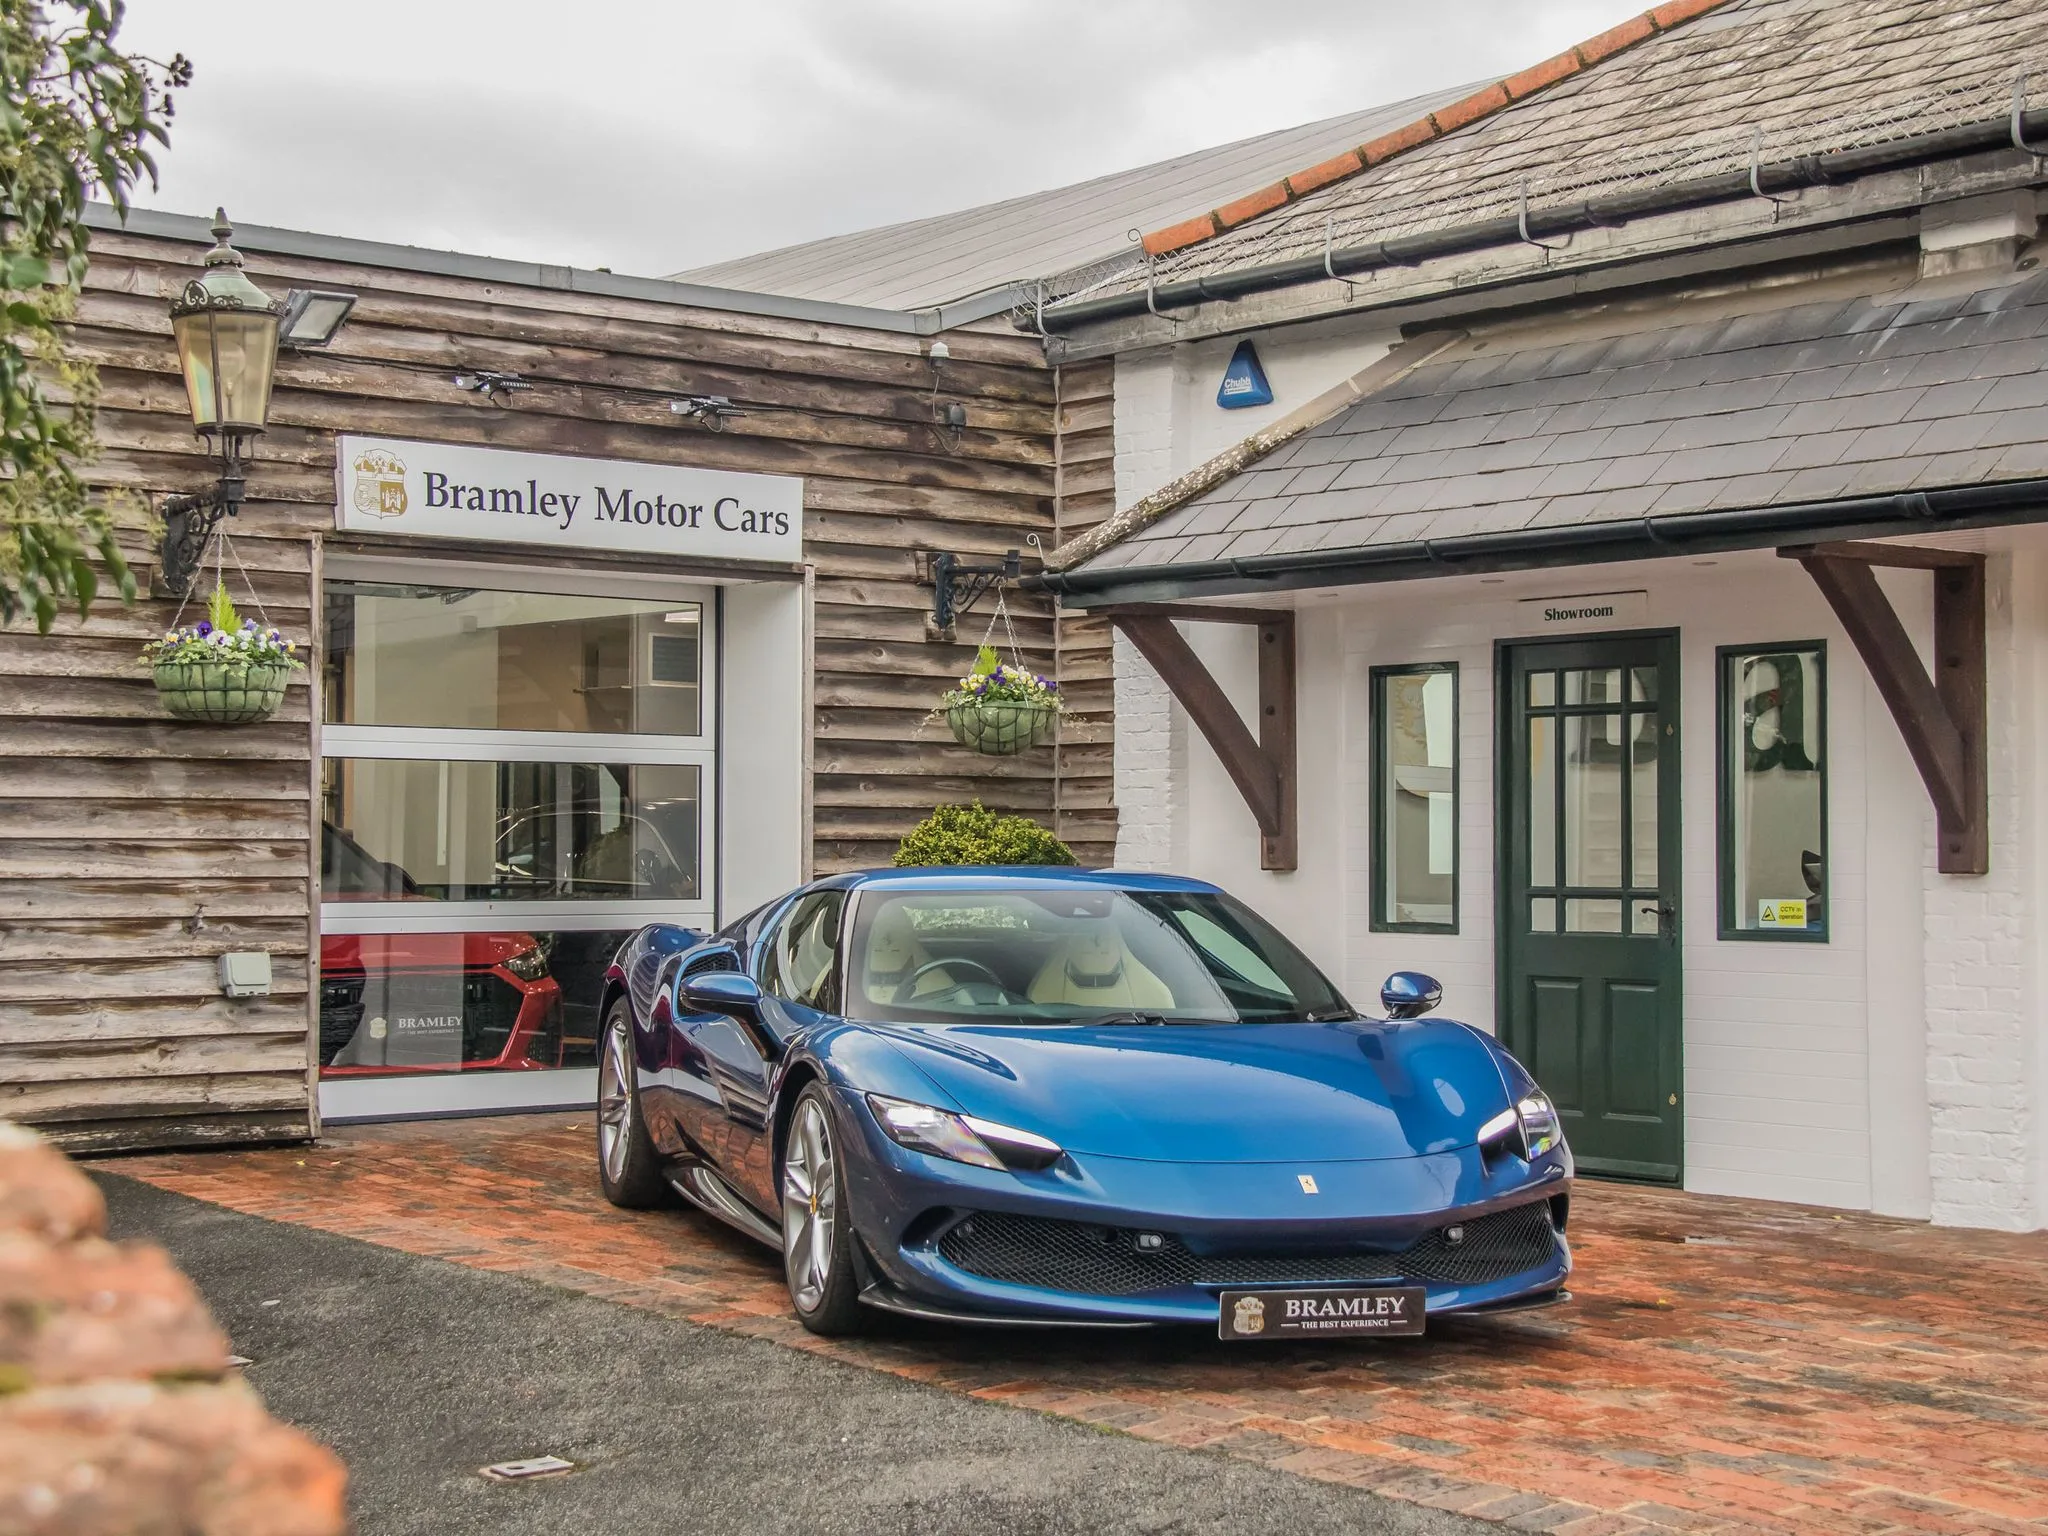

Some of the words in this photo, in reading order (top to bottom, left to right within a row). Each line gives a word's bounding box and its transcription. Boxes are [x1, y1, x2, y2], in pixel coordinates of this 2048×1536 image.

[1224, 376, 1251, 389] Chubb
[422, 471, 581, 530] Bramley
[594, 486, 703, 529] Motor
[713, 497, 790, 536] Cars
[1544, 605, 1614, 621] Showroom
[398, 1016, 463, 1028] BRAMLEY
[1285, 1296, 1405, 1318] BRAMLEY
[1301, 1321, 1318, 1329] THE
[1319, 1320, 1339, 1328] BEST
[1340, 1319, 1389, 1328] EXPERIENCE
